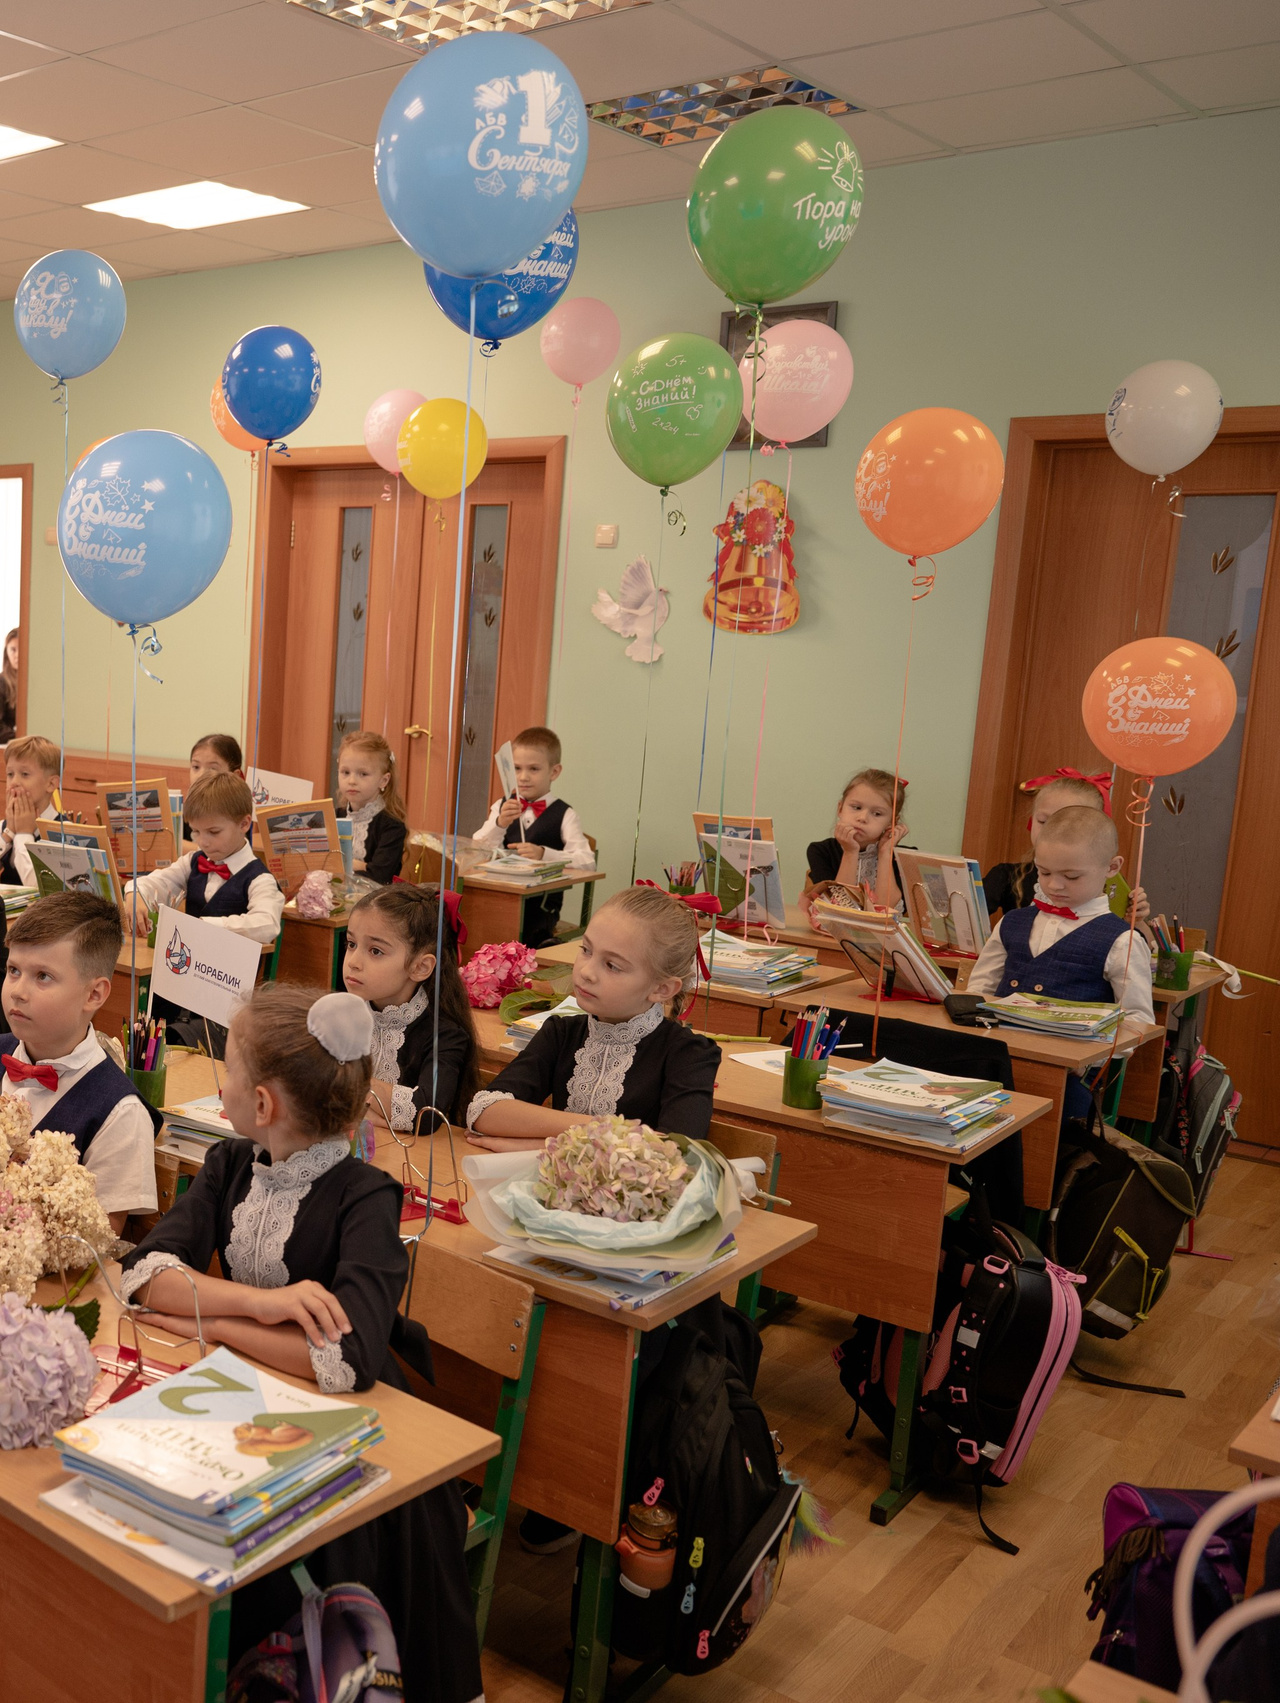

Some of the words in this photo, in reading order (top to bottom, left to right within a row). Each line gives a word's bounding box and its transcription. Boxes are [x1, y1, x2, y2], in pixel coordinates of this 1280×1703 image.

[518, 70, 551, 146] 1
[467, 125, 578, 187] Сентября
[793, 192, 846, 228] Пора
[20, 309, 74, 339] школу!
[665, 354, 687, 367] 5+
[635, 385, 697, 411] Знаний!
[639, 380, 650, 396] С
[1106, 706, 1191, 735] Знаний
[194, 960, 241, 989] КОРАБЛИК
[863, 1065, 919, 1082] 2
[158, 1367, 255, 1415] 2
